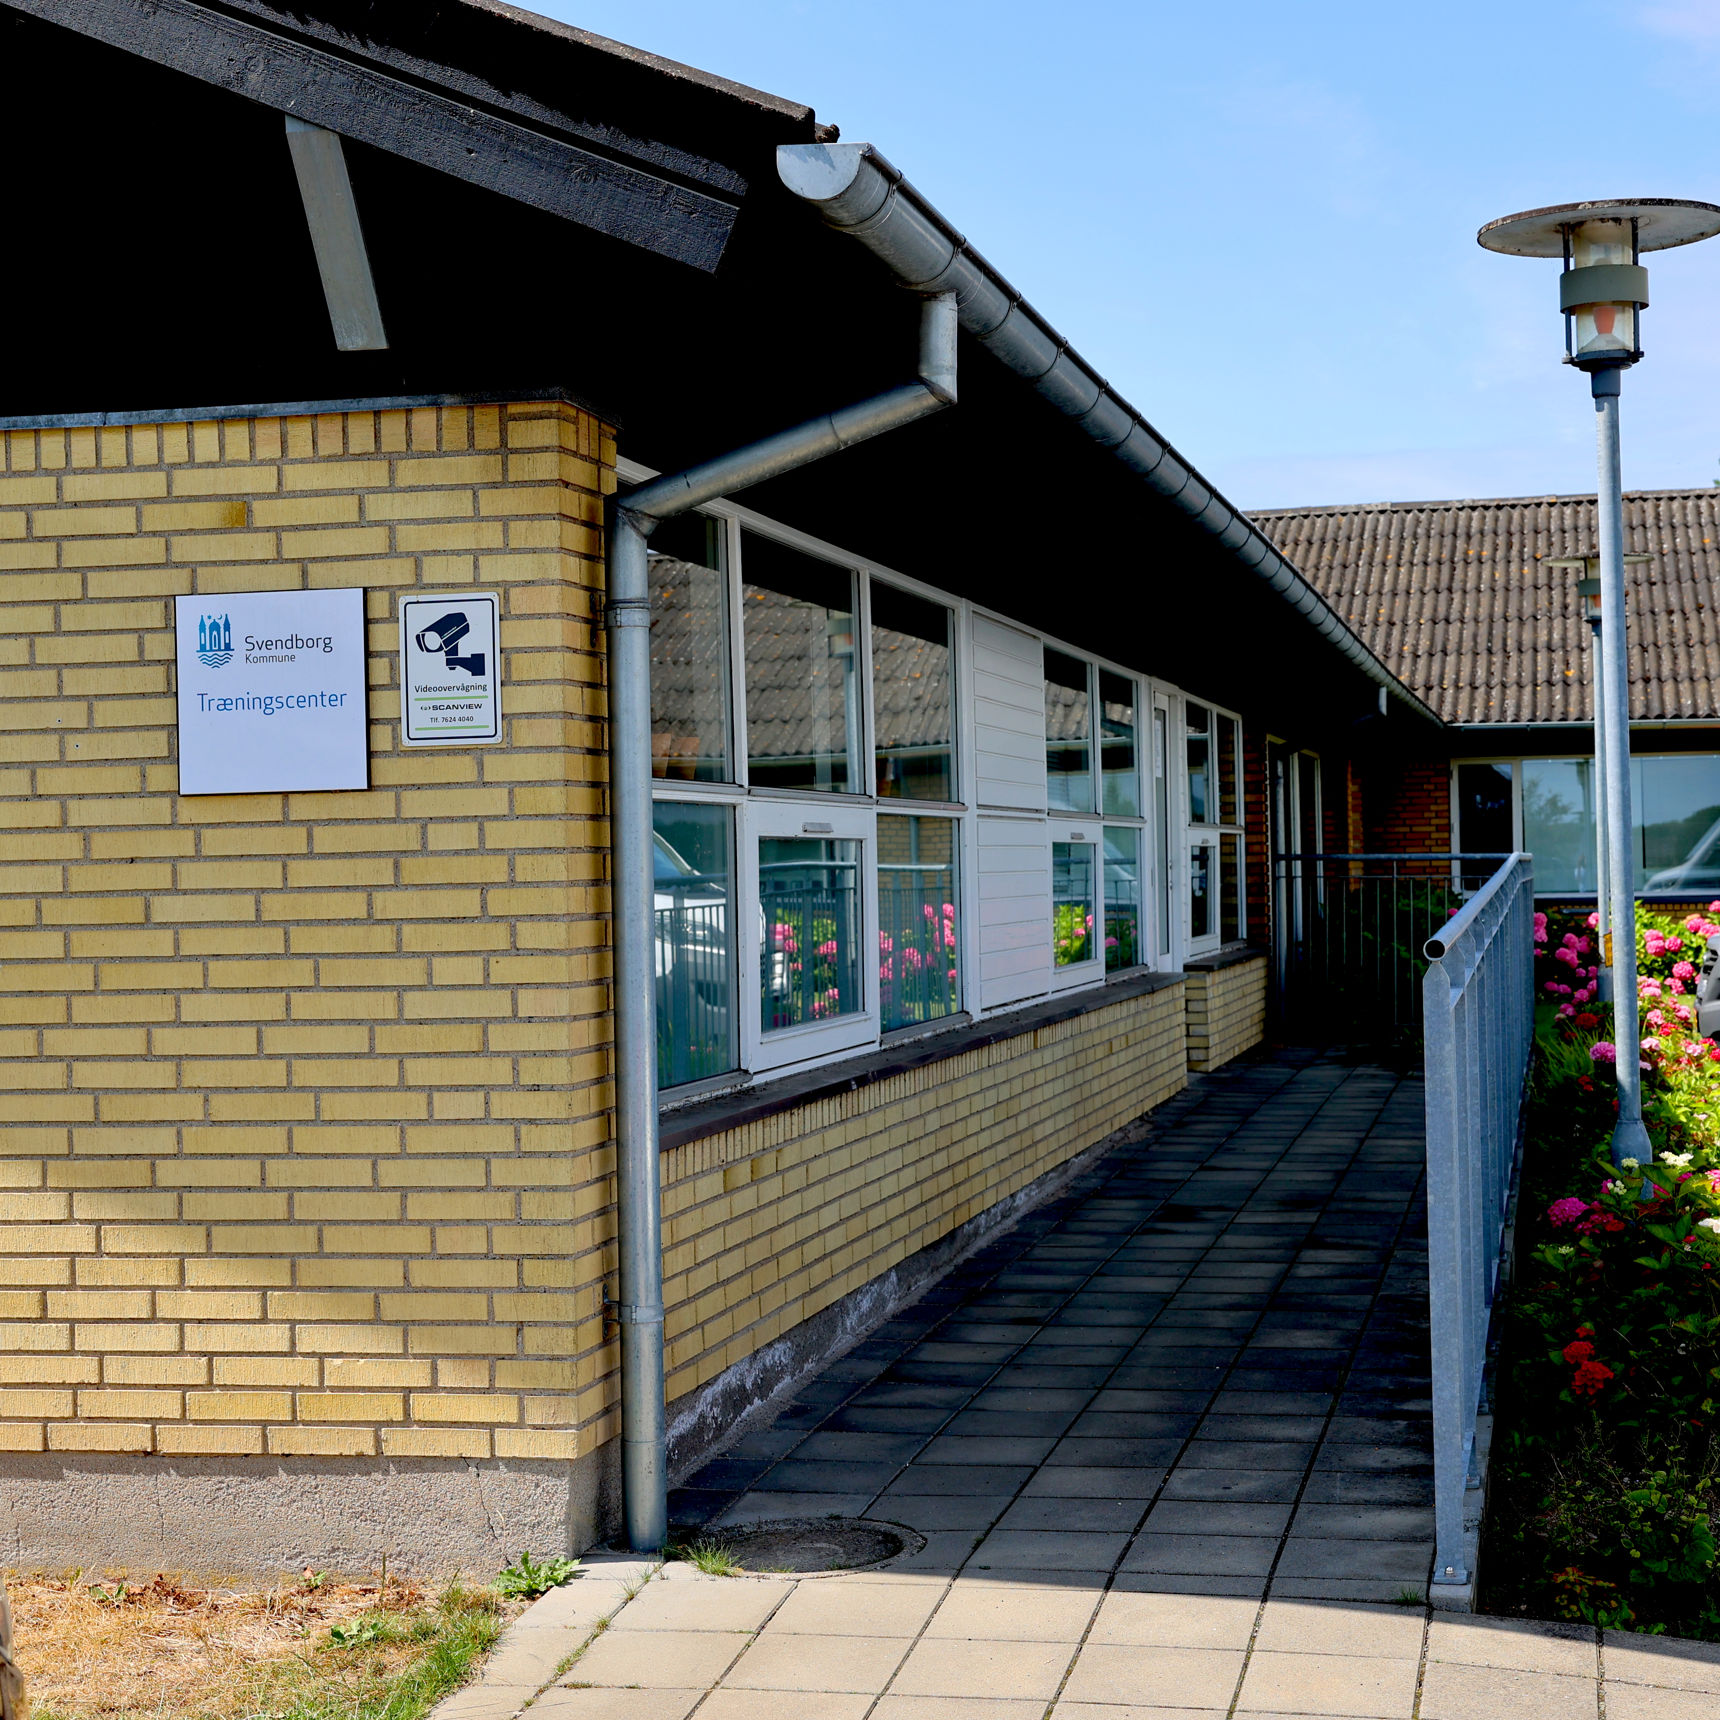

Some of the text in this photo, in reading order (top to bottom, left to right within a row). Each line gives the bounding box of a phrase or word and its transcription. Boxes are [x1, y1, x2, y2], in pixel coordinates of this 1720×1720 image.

[244, 633, 333, 653] Svendborg
[244, 654, 296, 664] Kommune
[414, 683, 488, 693] Videoovervågning
[197, 690, 348, 716] Træningscenter
